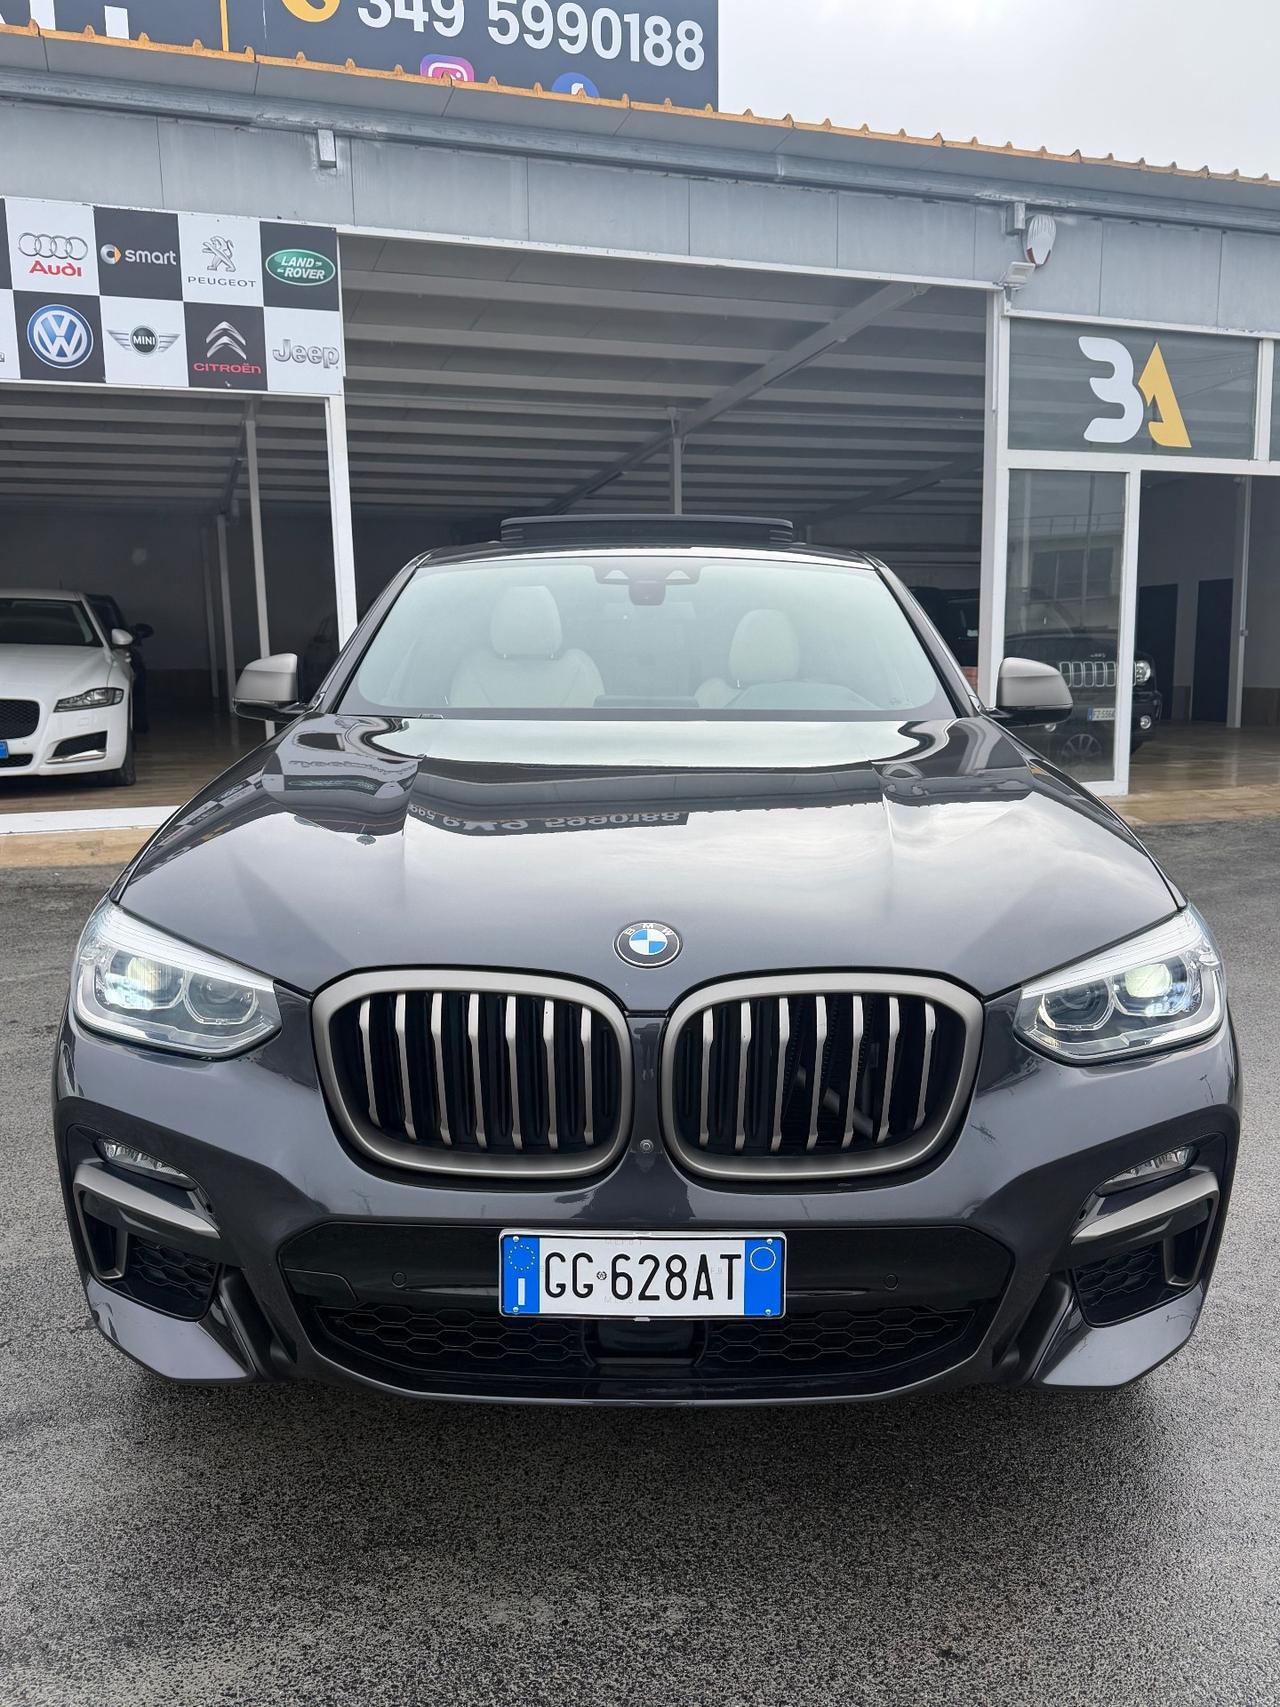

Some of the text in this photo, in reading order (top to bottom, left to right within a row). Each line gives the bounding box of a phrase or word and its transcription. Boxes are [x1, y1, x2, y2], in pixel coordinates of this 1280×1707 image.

[357, 0, 706, 71] 349 5990188
[125, 248, 177, 266] smart
[281, 256, 315, 268] LAND
[29, 260, 82, 277] Audi
[284, 267, 325, 280] ROVER
[187, 276, 257, 288] PEUGEOT
[132, 334, 156, 346] MINI
[272, 338, 340, 369] Jeep
[193, 361, 262, 375] CITROËN
[623, 922, 675, 936] BMW
[544, 1251, 742, 1301] GG 628AT
